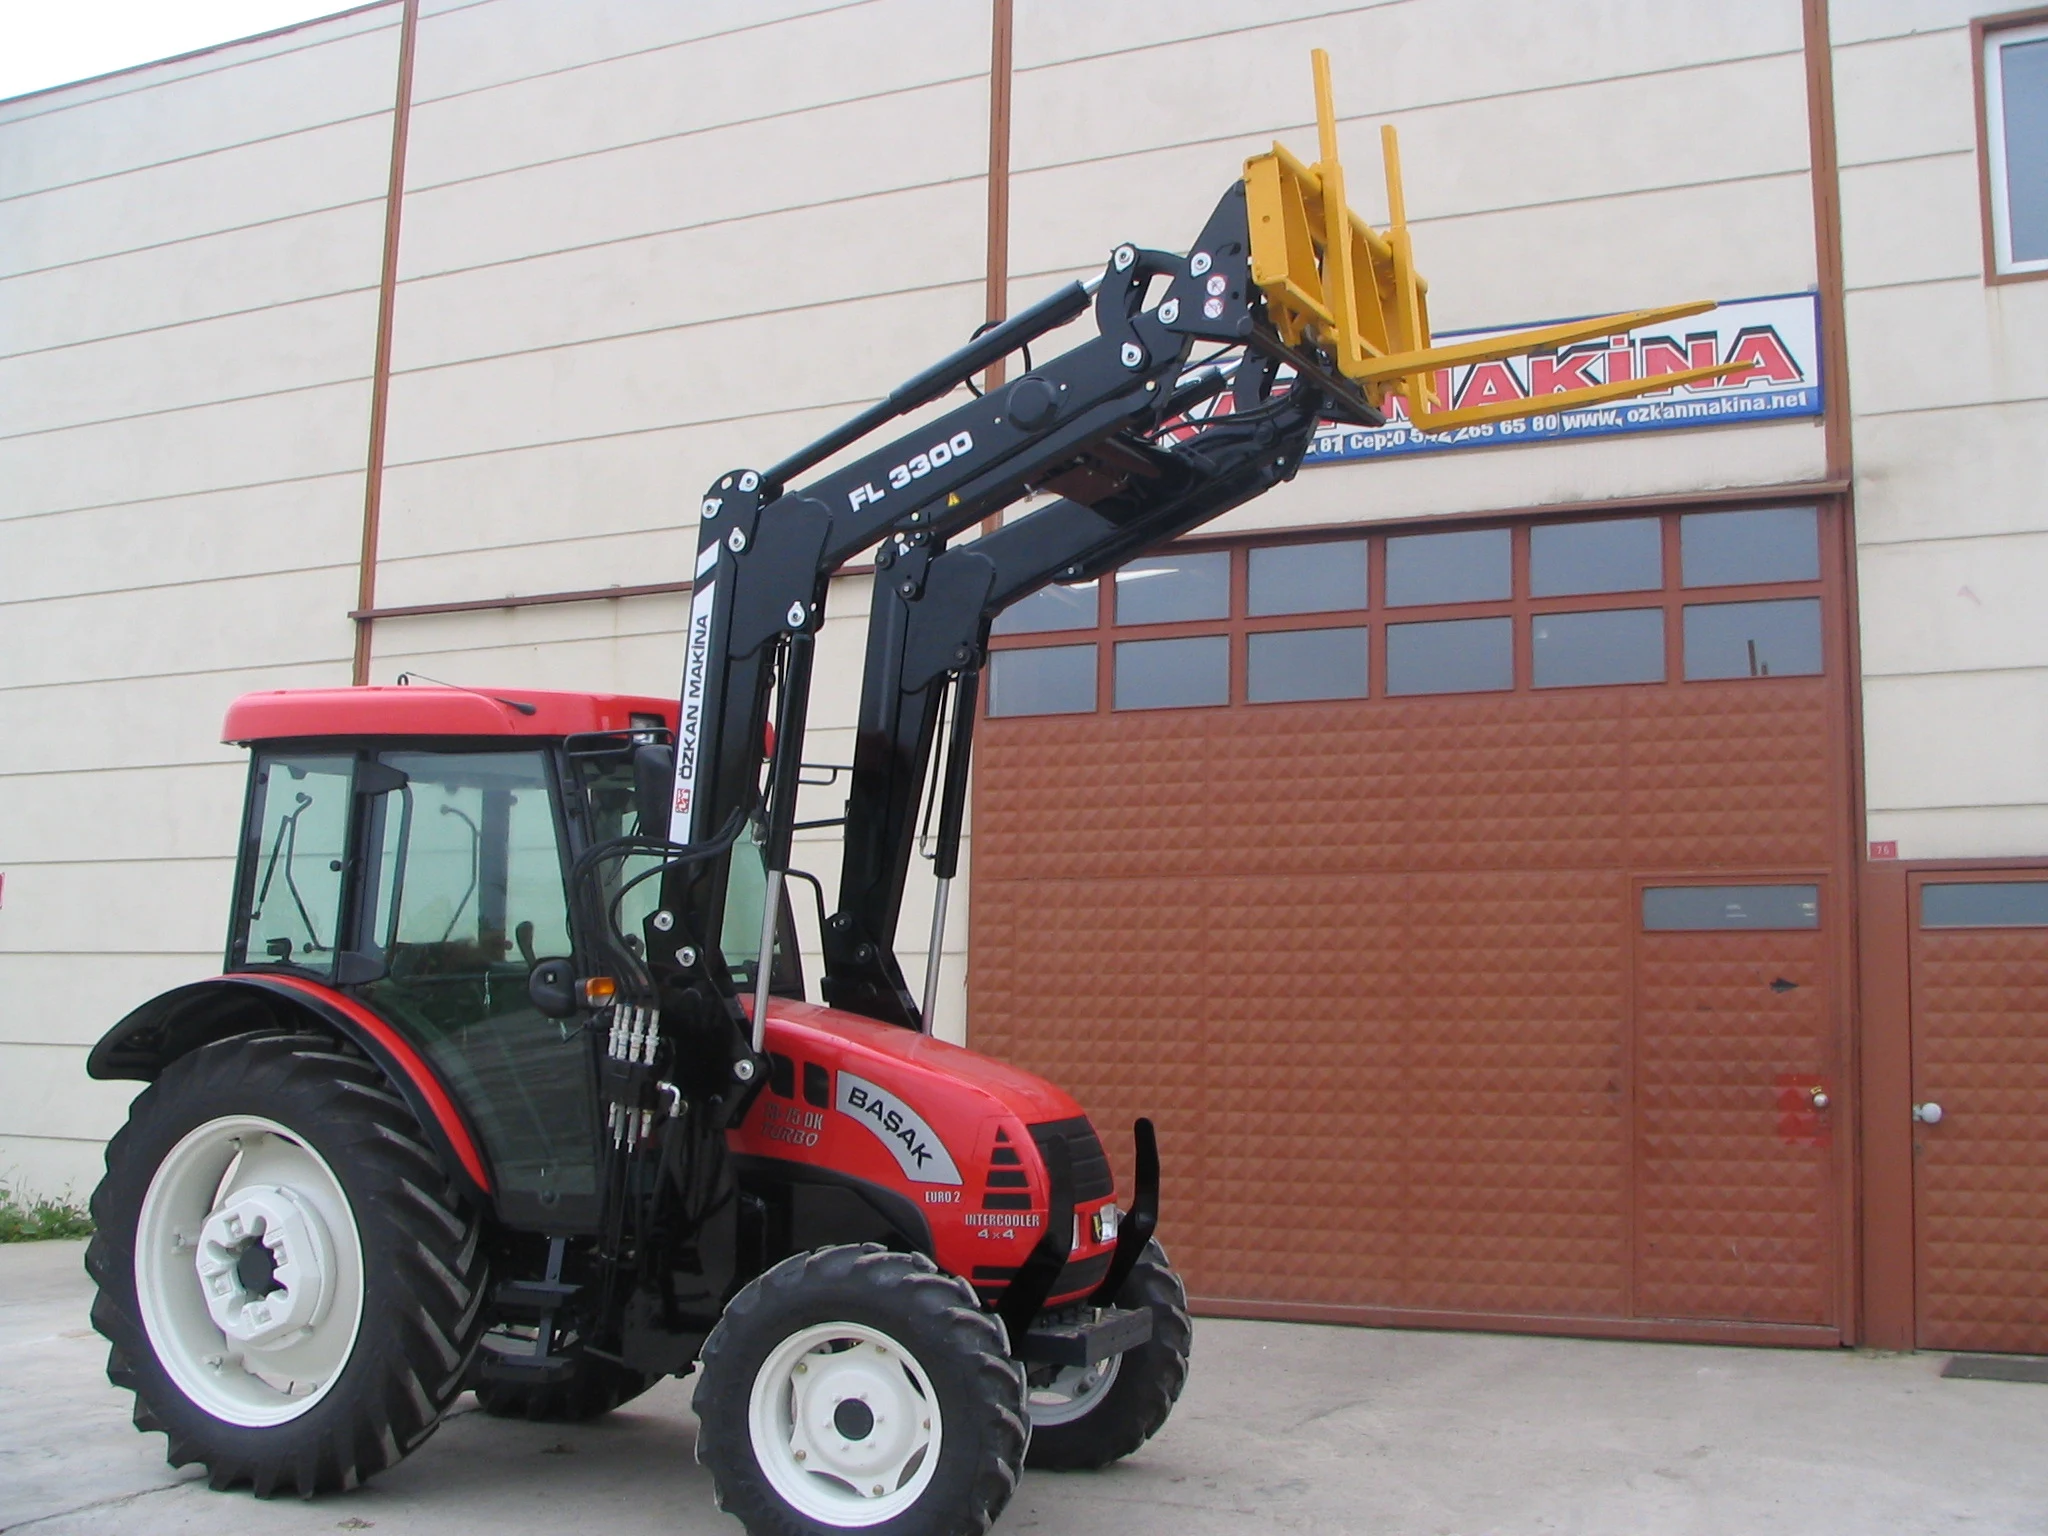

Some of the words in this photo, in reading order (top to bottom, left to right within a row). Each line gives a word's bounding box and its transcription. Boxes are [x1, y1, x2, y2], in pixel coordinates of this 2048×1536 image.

[1500, 418, 1526, 435] 65
[848, 482, 885, 513] FL
[888, 430, 973, 490] 3300
[688, 614, 709, 698] MAKİNA
[678, 704, 699, 780] ÖZKAN
[762, 1121, 819, 1147] TURBO
[847, 1086, 933, 1170] BAŞAK
[925, 1191, 952, 1203] EURO
[953, 1191, 961, 1203] 2
[965, 1213, 1040, 1227] INTERCOOLER
